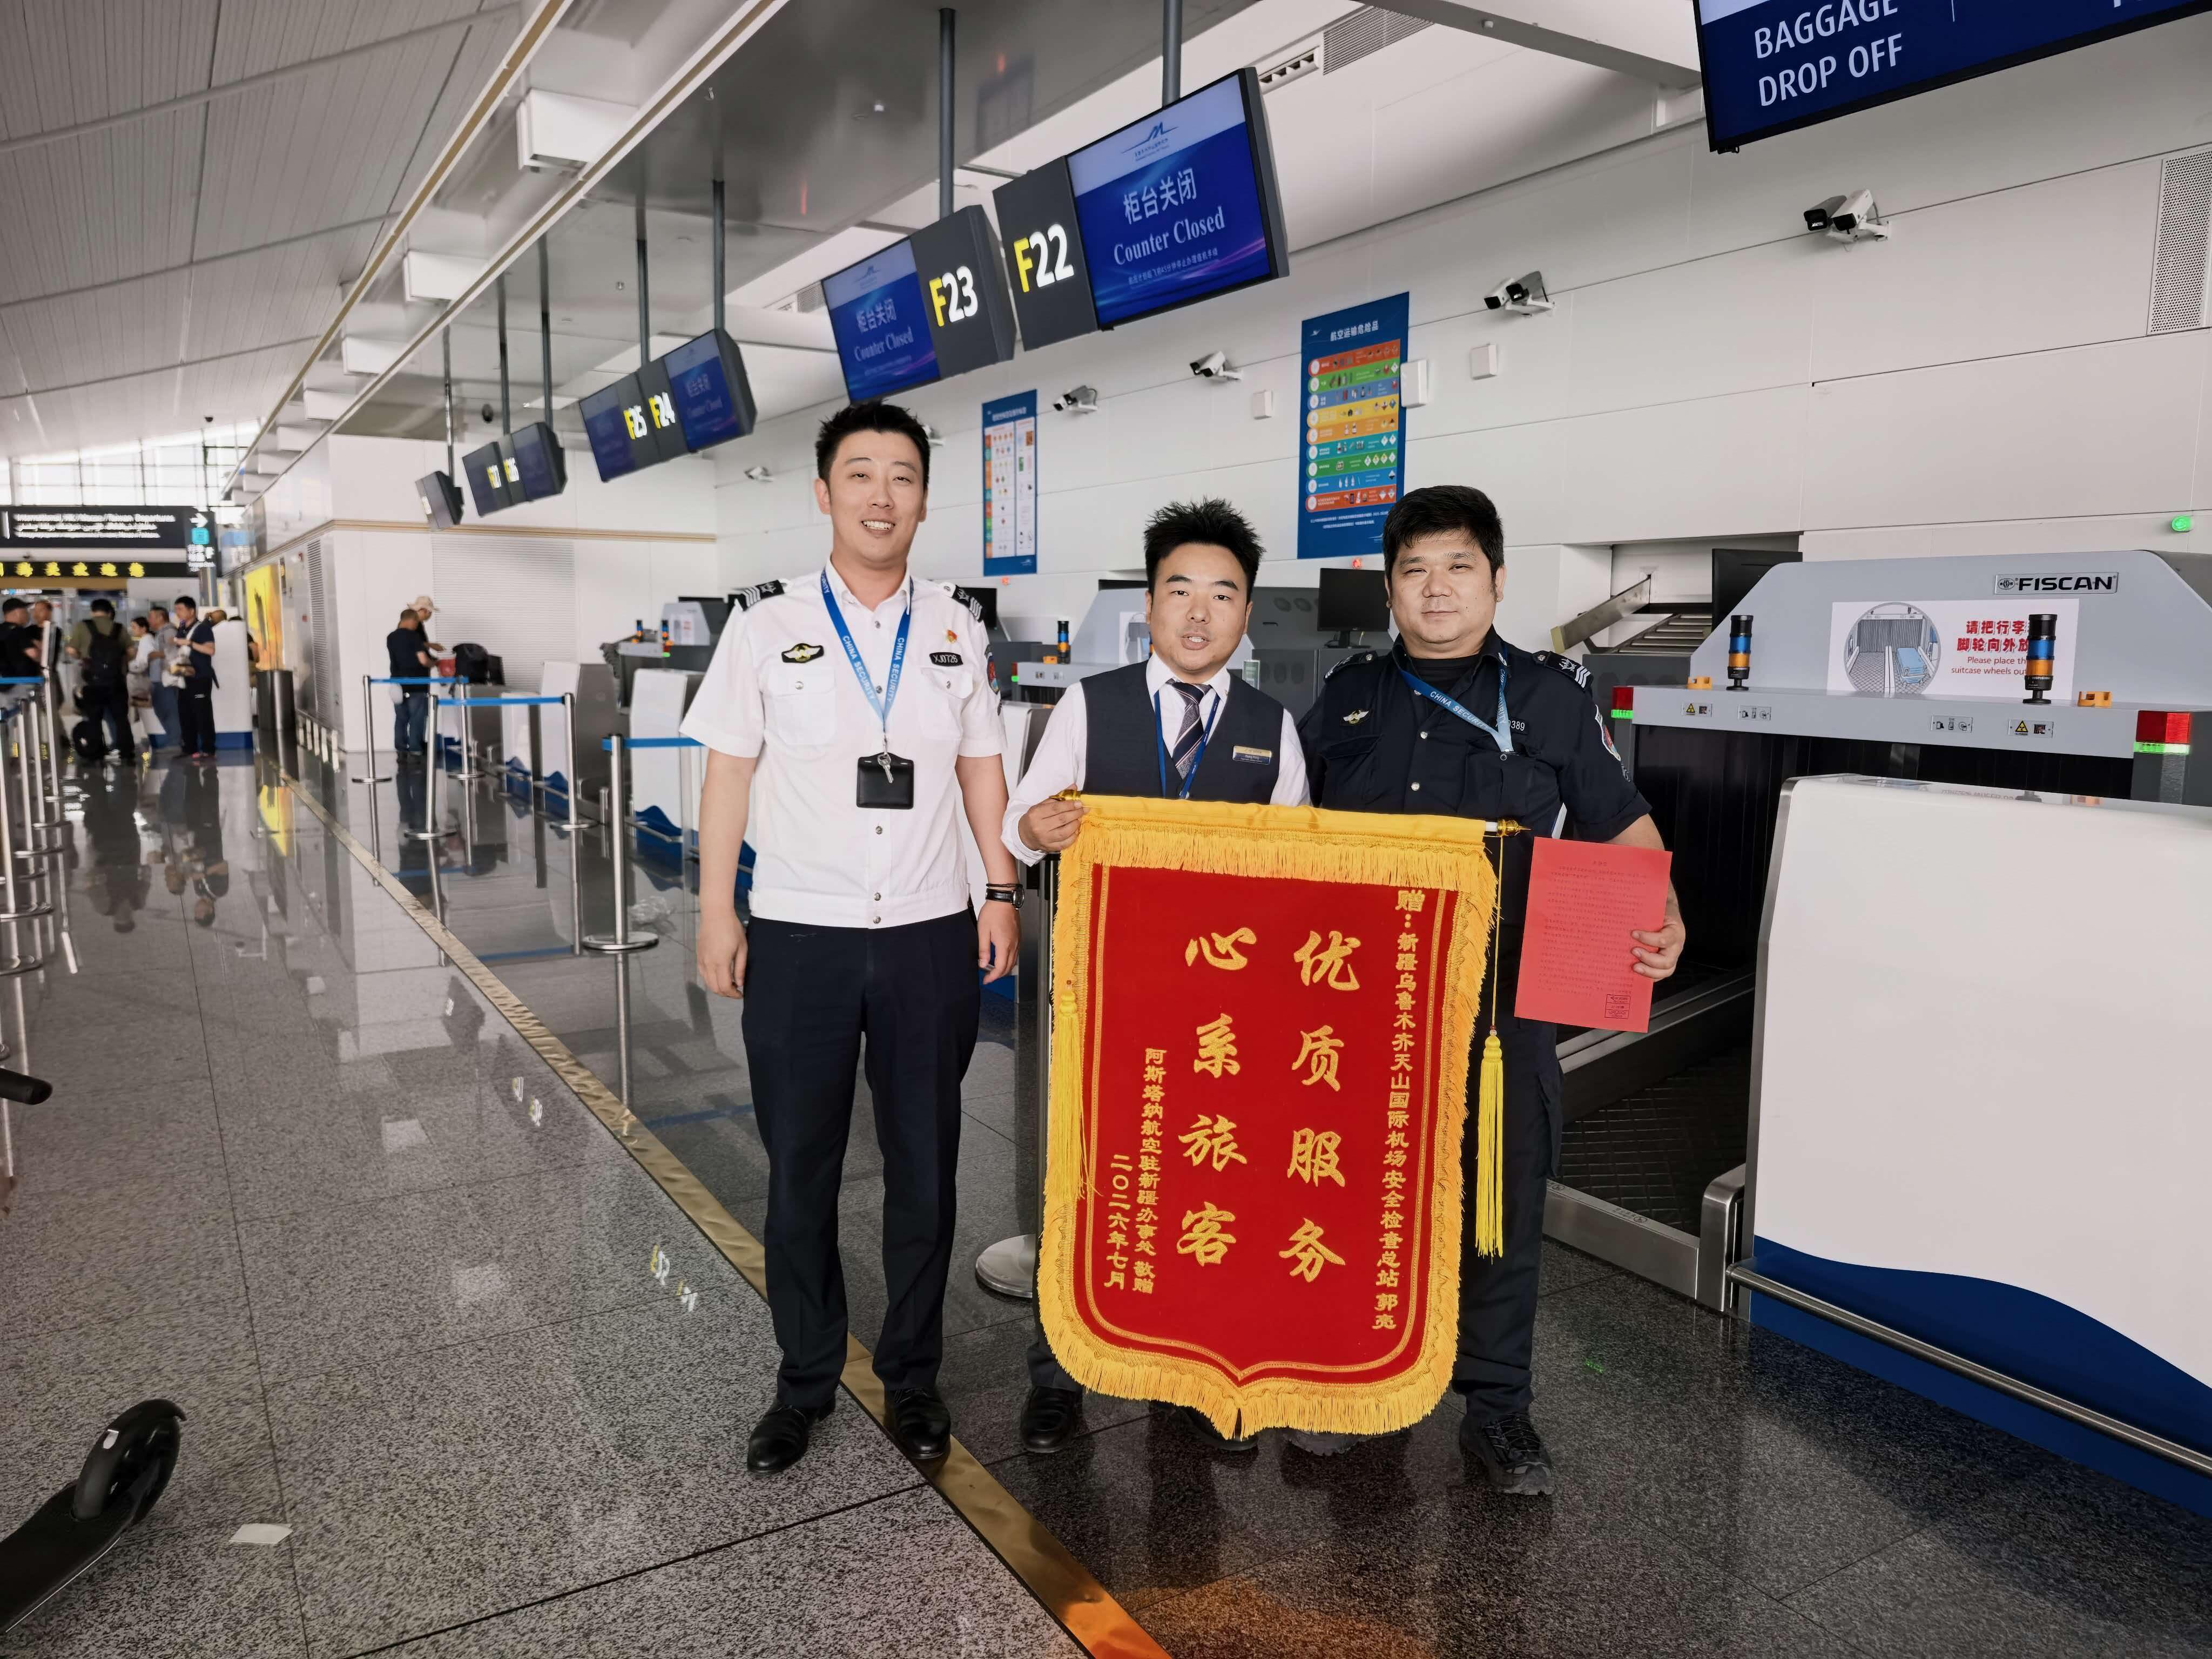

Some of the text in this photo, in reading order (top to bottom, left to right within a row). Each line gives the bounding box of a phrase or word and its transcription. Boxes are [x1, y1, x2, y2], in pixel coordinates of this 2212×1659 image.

[1759, 33, 1901, 106] DROP OFF
[1123, 167, 1197, 225] 柜台关闭
[1014, 224, 1074, 293] F22
[1114, 205, 1225, 265] Counter Closed
[856, 298, 897, 334] 柜台关闭
[929, 266, 979, 327] F23
[854, 326, 914, 362] Counter Closed
[648, 392, 676, 429] F24
[2019, 576, 2113, 591] FISCAN
[1966, 621, 2029, 635] 请把行李
[843, 636, 875, 700] CHINA SECURITY
[886, 637, 905, 703] CHINA SECURITY
[934, 655, 958, 663] XJ0726
[1994, 657, 2015, 665] place
[1430, 691, 1488, 730] CHINA SECURITY
[1176, 927, 1257, 1266] 心系旅客
[1278, 930, 1361, 1283] 优质服务
